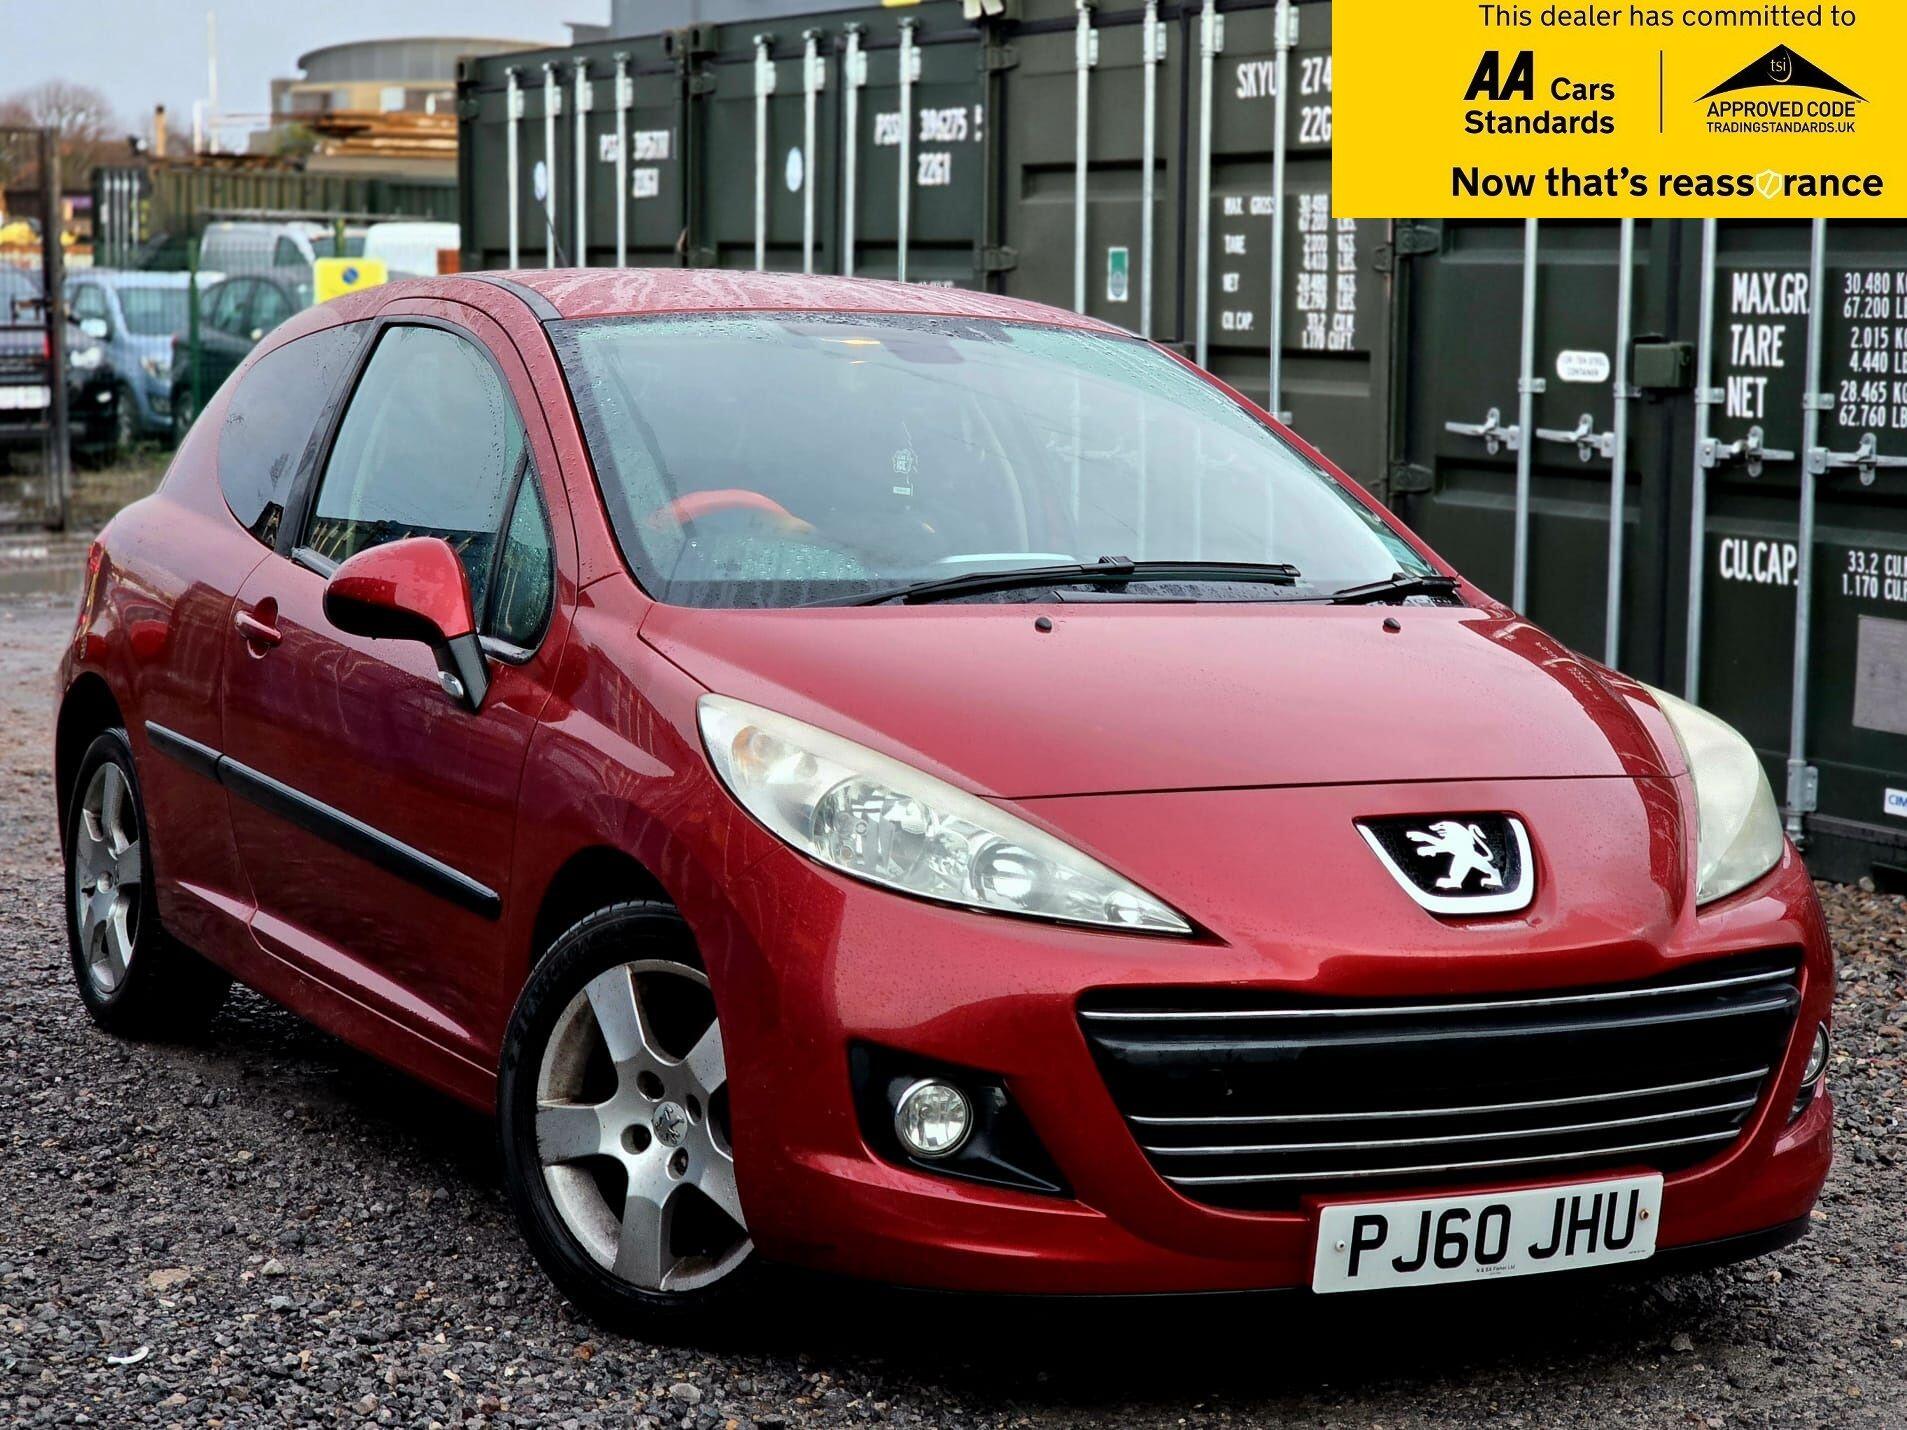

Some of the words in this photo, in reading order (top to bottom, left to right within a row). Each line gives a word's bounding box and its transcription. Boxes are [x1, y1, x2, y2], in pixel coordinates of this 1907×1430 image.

[1844, 271, 1890, 296] 30.480
[1843, 296, 1890, 319] 67.200
[1730, 323, 1786, 368] TARE
[1850, 326, 1889, 349] 2.015
[1849, 350, 1889, 373] 4.440
[1726, 376, 1768, 419] NET
[1840, 379, 1888, 403] 28.465
[1839, 404, 1887, 428] 62.760
[1719, 538, 1799, 587] CU.CAP.
[1847, 550, 1879, 575] 33.2
[1842, 572, 1879, 599] 1.170
[1347, 1203, 1512, 1277] PJ60
[1527, 1188, 1640, 1260] JHU
